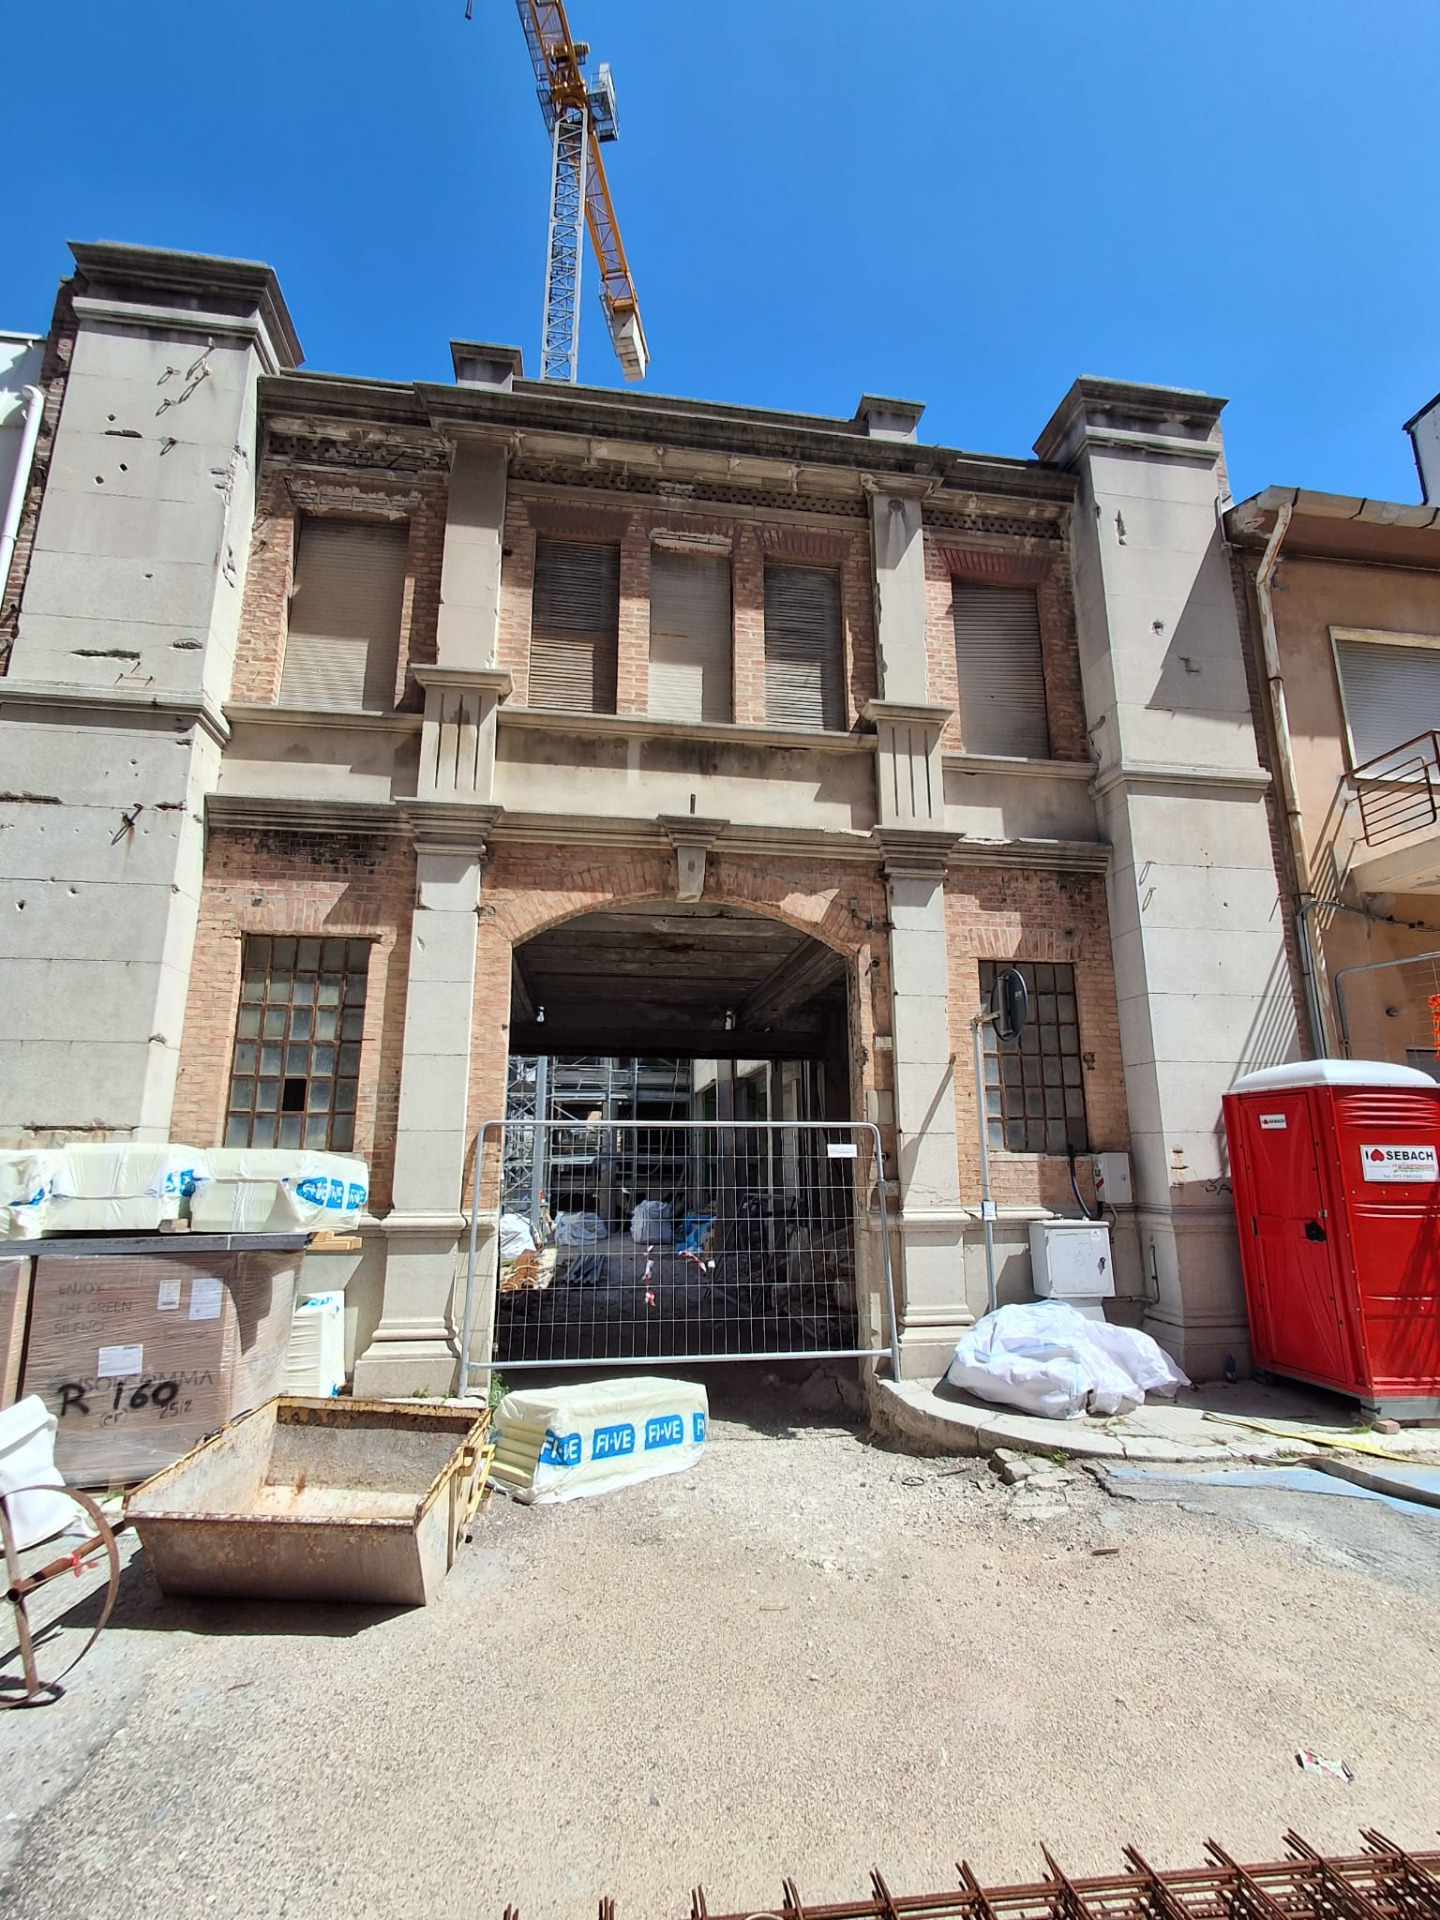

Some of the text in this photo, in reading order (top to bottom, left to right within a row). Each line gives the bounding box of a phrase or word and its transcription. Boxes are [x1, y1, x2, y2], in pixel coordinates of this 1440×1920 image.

[1386, 1150, 1434, 1161] SEBACH
[57, 1300, 133, 1315] THE GREEN
[57, 1380, 178, 1416] R 160
